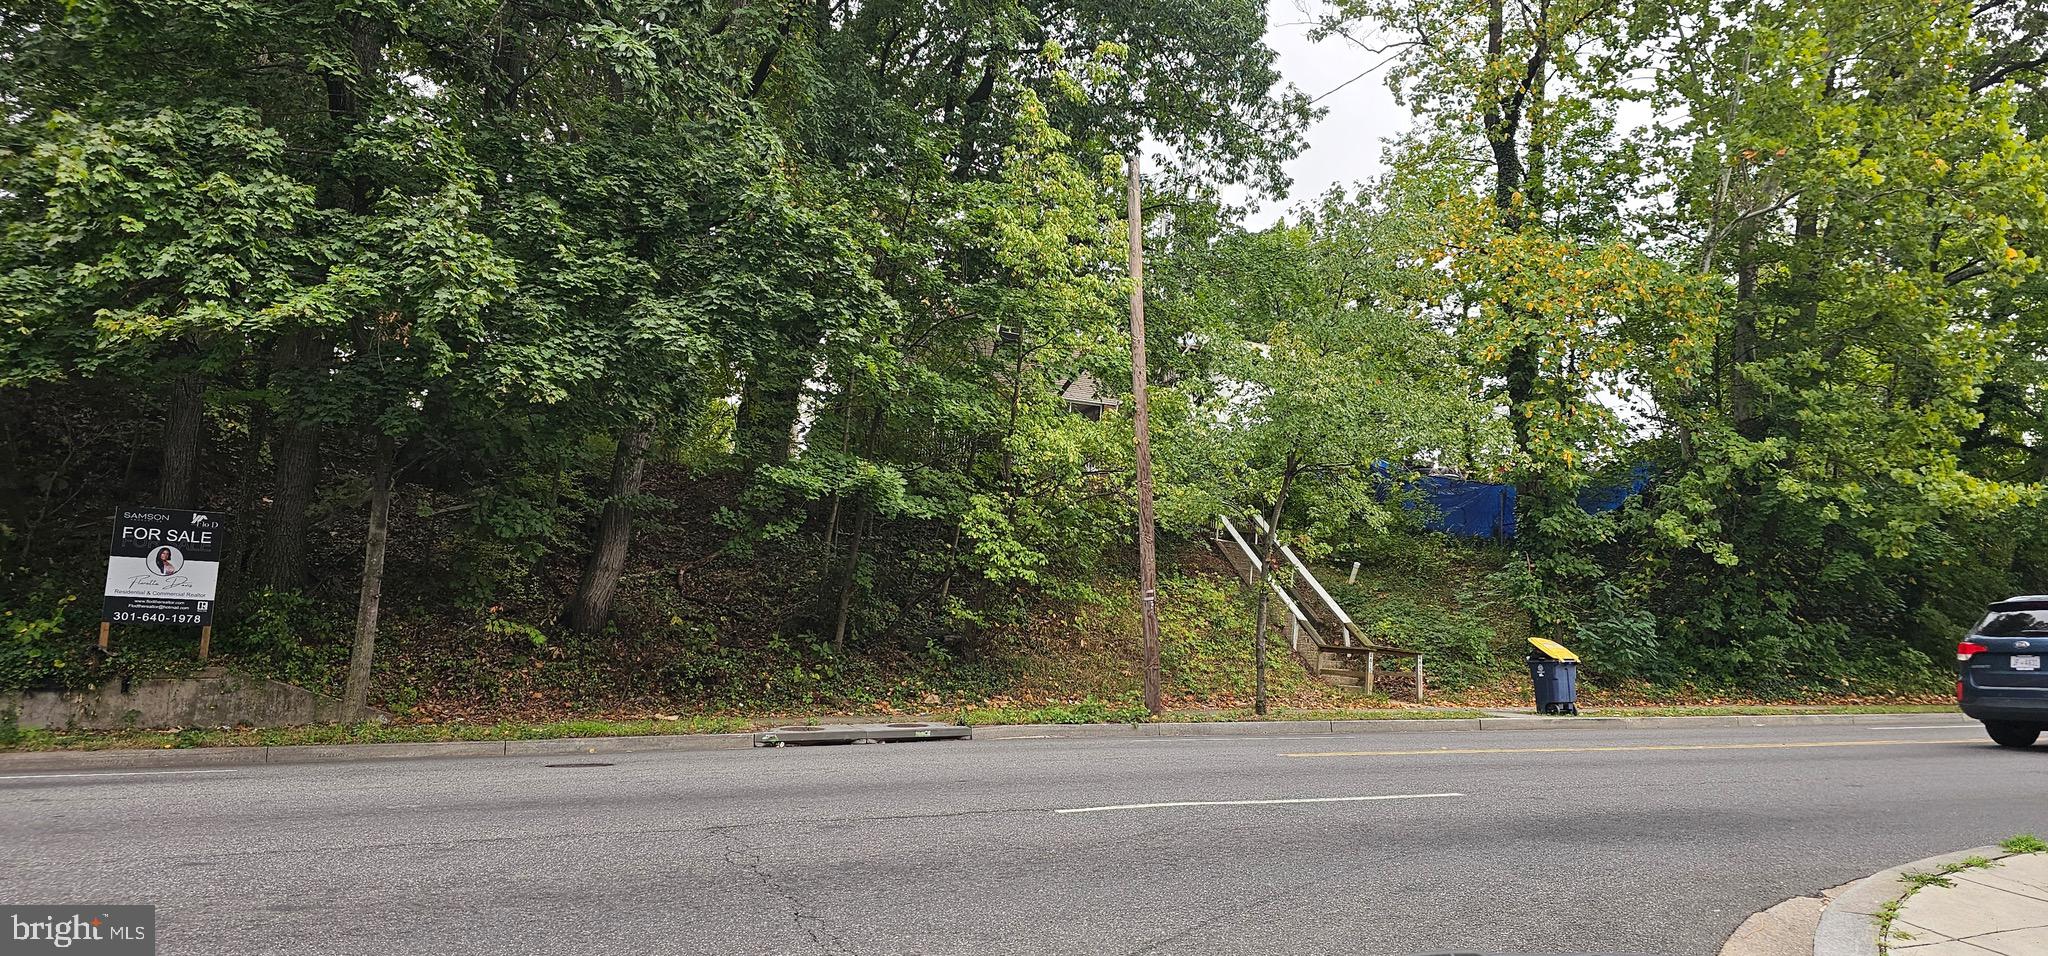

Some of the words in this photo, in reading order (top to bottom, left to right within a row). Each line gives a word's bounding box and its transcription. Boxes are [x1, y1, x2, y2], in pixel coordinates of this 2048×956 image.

[123, 511, 170, 521] SAMSON
[122, 526, 161, 541] FOR
[166, 529, 213, 544] SALE
[114, 588, 146, 596] Residential
[113, 611, 201, 624] 301-640-1978
